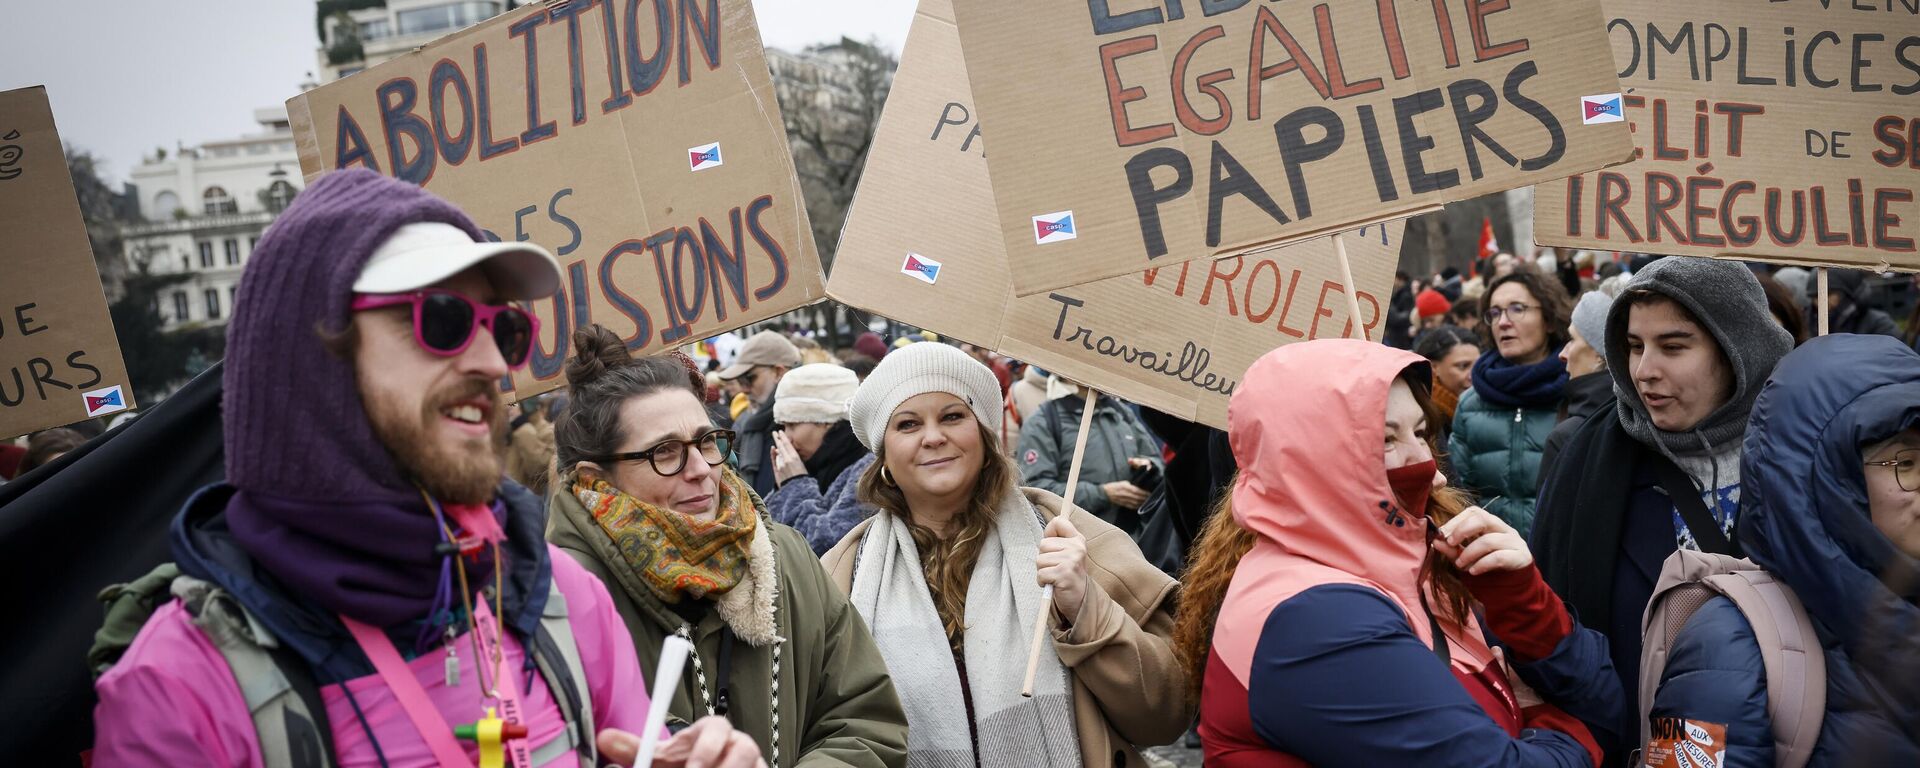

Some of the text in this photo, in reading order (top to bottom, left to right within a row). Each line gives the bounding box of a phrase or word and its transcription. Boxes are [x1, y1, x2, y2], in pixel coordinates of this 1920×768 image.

[335, 0, 721, 187] ABOLITION
[1805, 129, 1851, 158] DE
[1124, 60, 1567, 260] PAPIERS
[1691, 729, 1709, 742] AUX
